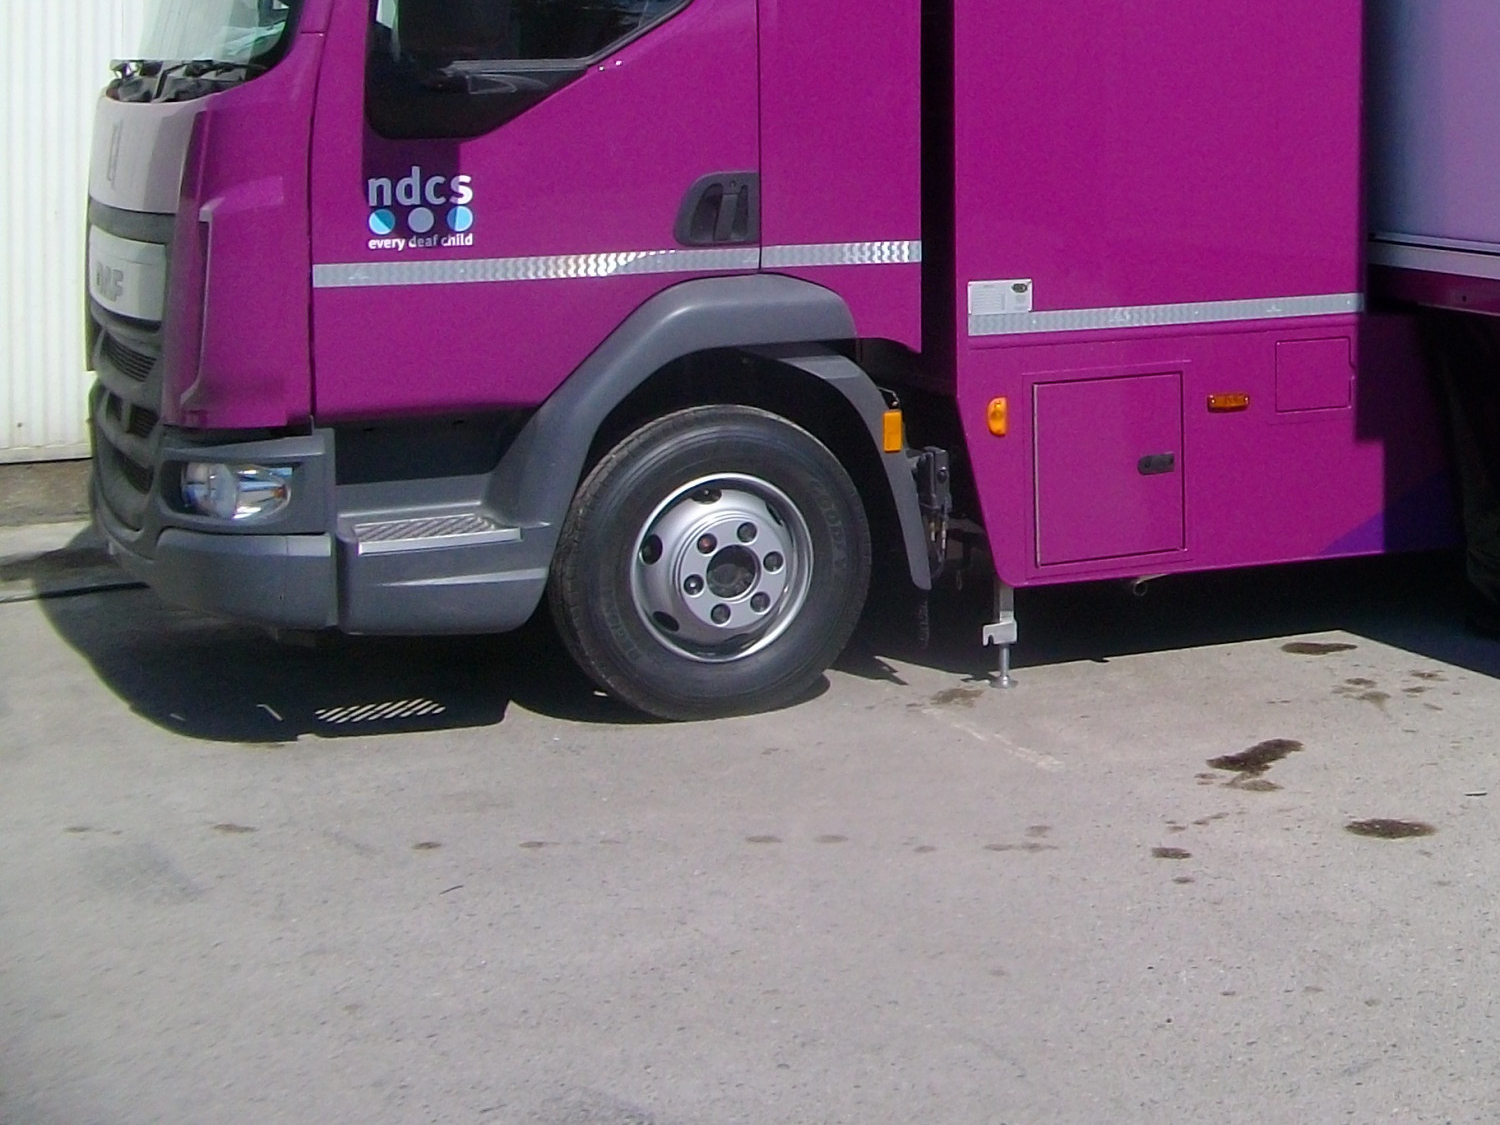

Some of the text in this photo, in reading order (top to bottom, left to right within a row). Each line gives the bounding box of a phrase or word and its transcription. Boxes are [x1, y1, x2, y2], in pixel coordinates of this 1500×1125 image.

[368, 165, 474, 207] ndcs
[367, 232, 474, 252] every deaf child
